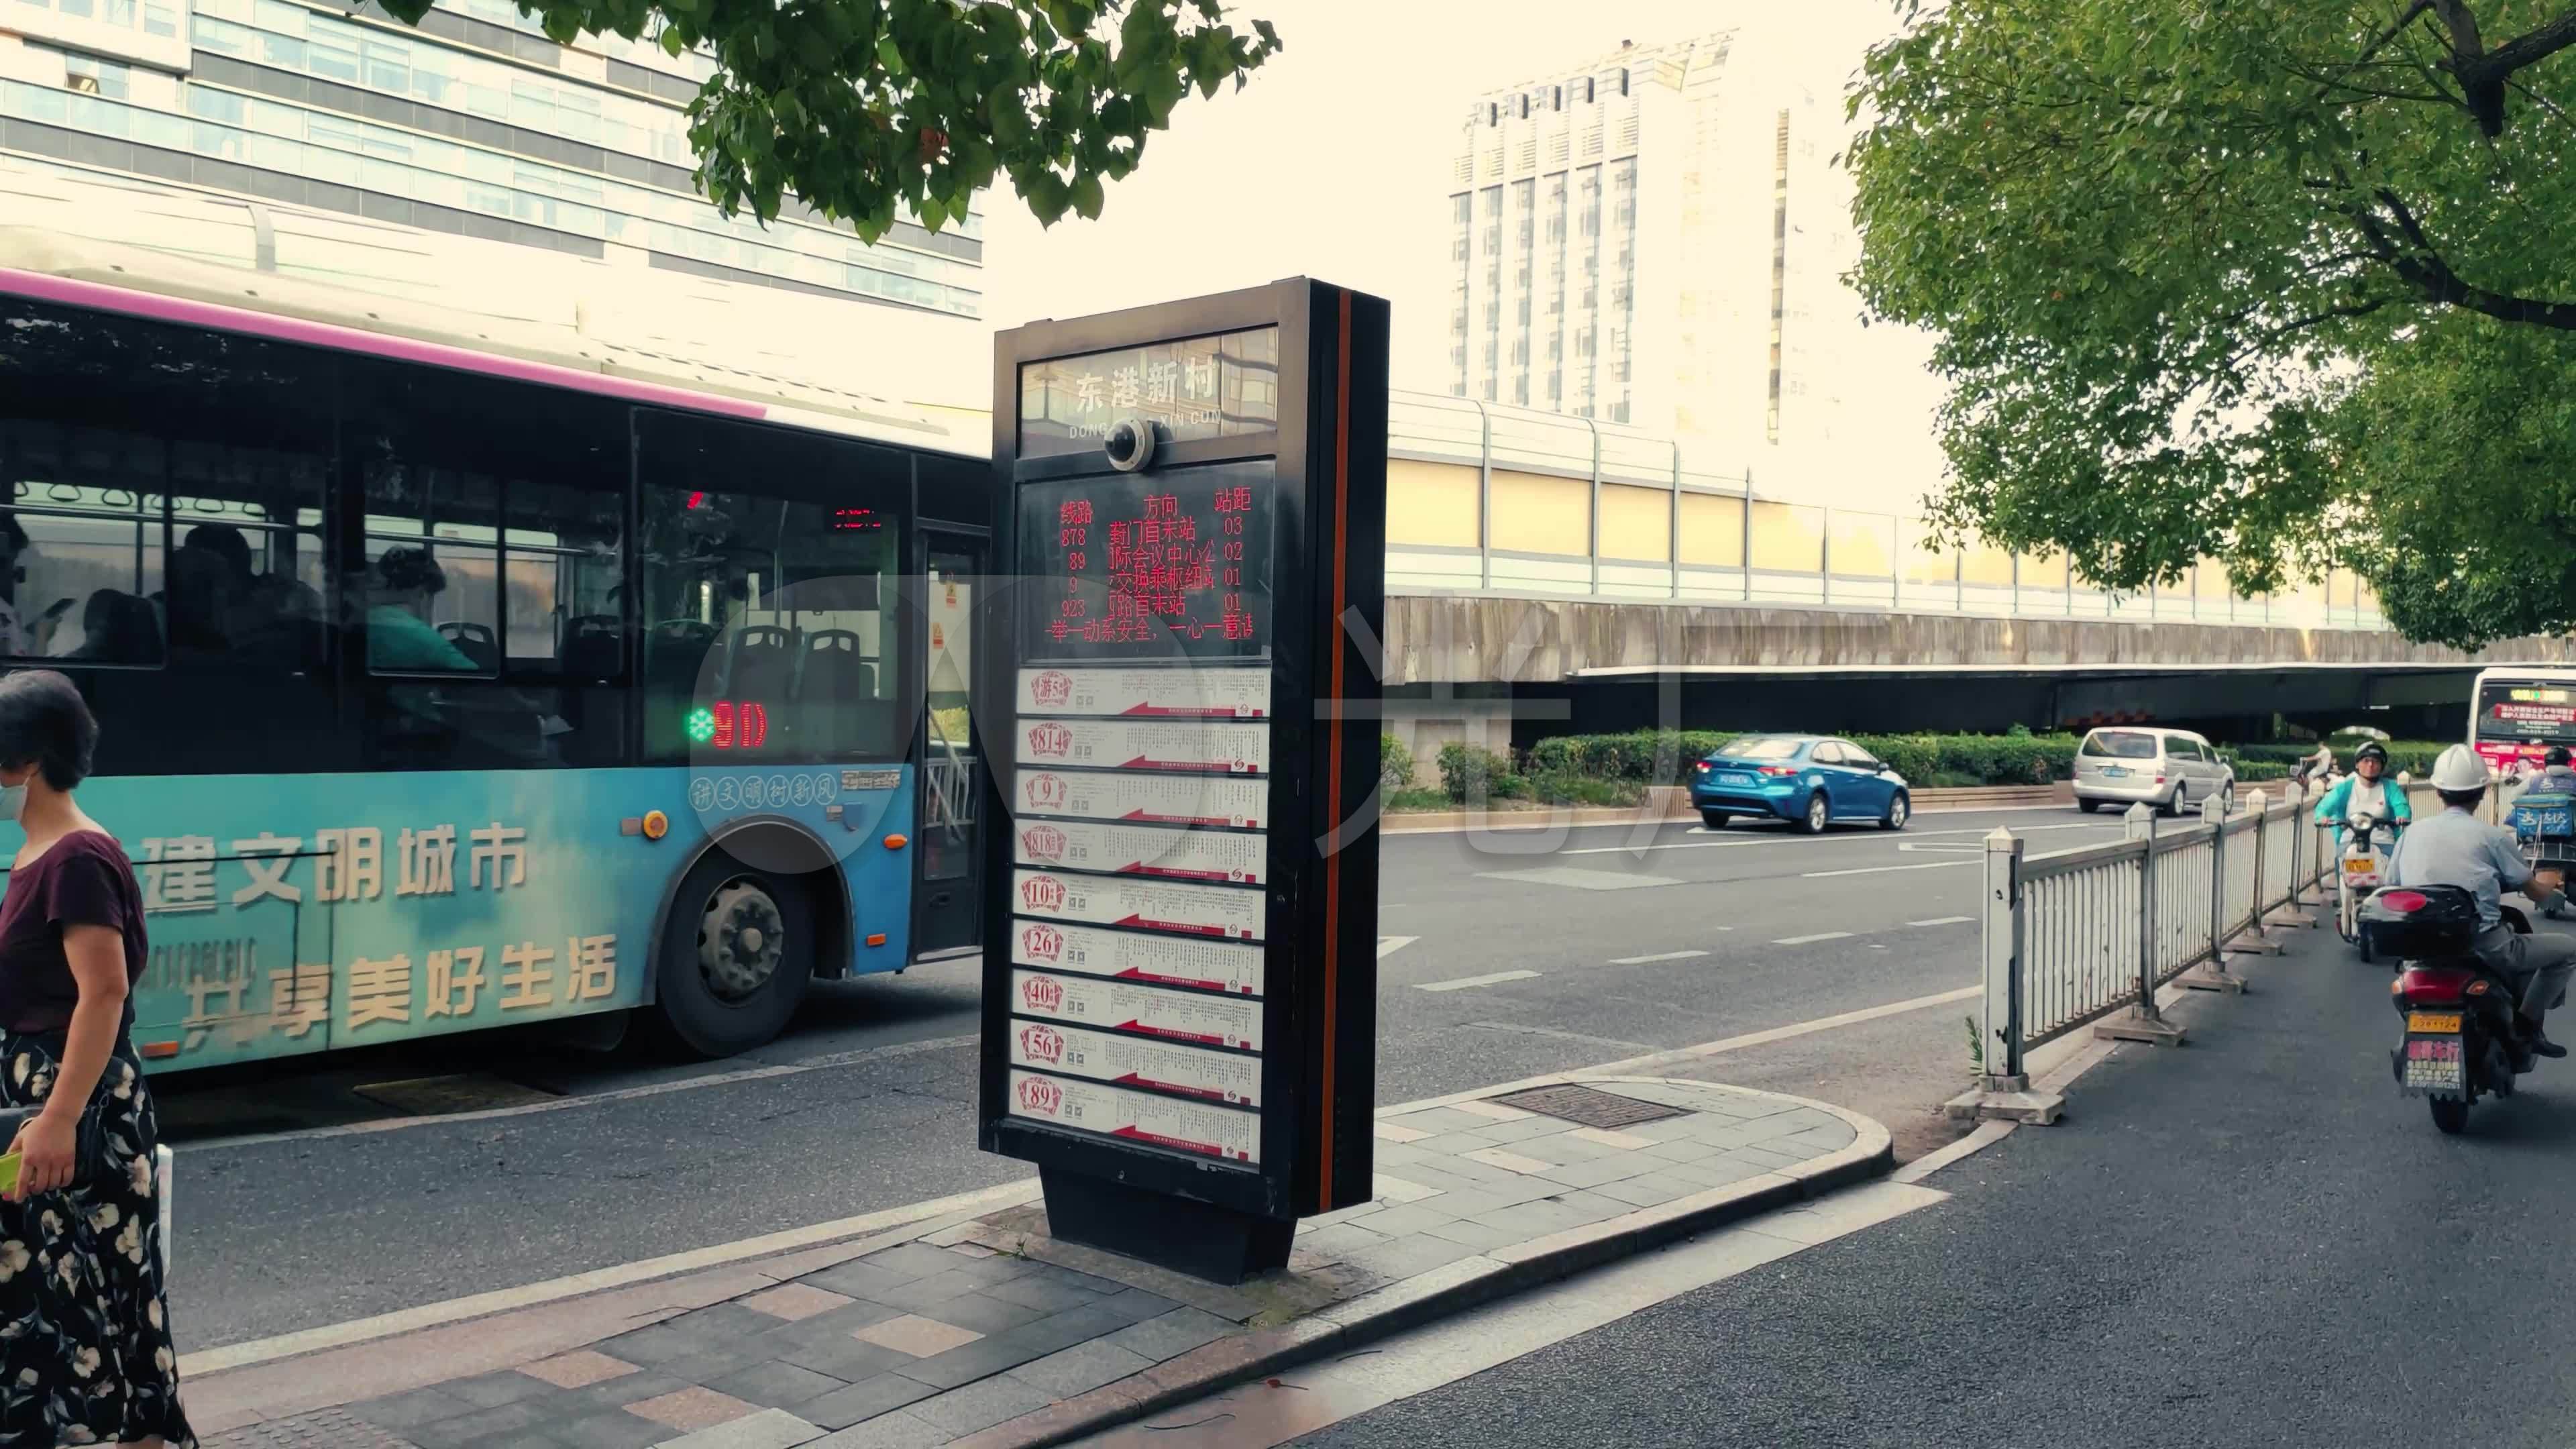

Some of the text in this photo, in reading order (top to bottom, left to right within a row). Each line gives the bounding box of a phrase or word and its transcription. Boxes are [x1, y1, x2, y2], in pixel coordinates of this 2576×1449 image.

[1076, 354, 1216, 413] 东港新村
[1069, 409, 1222, 439] DONG XIN CUN
[1060, 487, 1252, 525] 线路 方向 站距
[1061, 528, 1085, 547] 878
[1224, 517, 1242, 536] 03
[1069, 552, 1085, 570] 89
[1224, 541, 1243, 561] 02
[1224, 568, 1241, 586] 01
[1062, 598, 1085, 617] 923
[1224, 593, 1241, 612] 01
[1038, 729, 1063, 750] 814
[693, 774, 835, 807] 讲文明树新风
[1043, 781, 1052, 800] 9
[1031, 834, 1052, 851] 818
[142, 822, 529, 914] 建文明城市
[1031, 883, 1049, 904] 10
[1033, 932, 1052, 953] 26
[182, 934, 618, 1051] 共享美好生活
[1031, 983, 1049, 1003] 40
[1033, 1034, 1052, 1055] 56
[1030, 1083, 1050, 1106] 89
